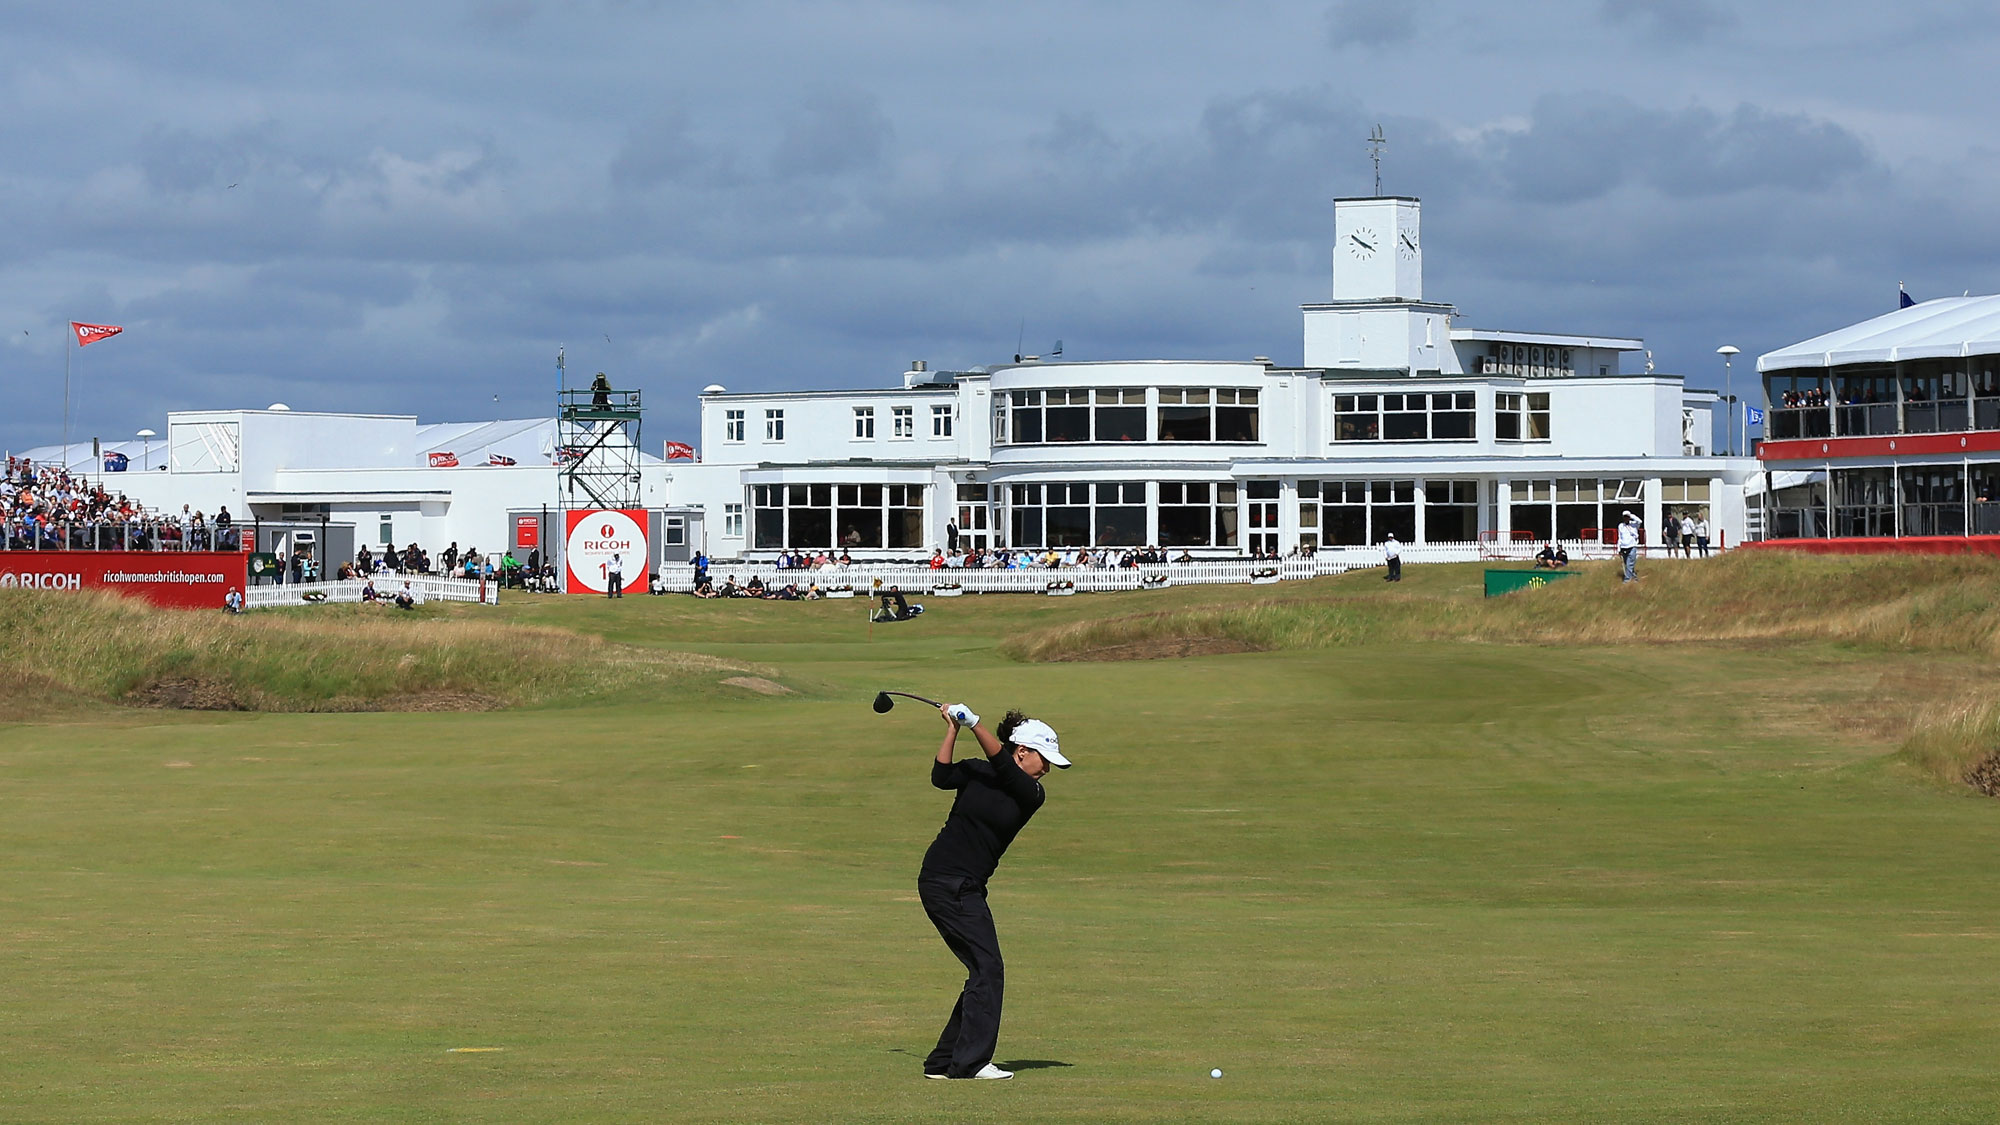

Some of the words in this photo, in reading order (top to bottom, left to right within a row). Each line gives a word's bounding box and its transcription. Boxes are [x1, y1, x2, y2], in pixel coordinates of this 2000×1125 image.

[584, 540, 630, 550] RICOH
[21, 573, 81, 590] RICOH
[104, 570, 224, 585] ricohwomensbritishopen.com
